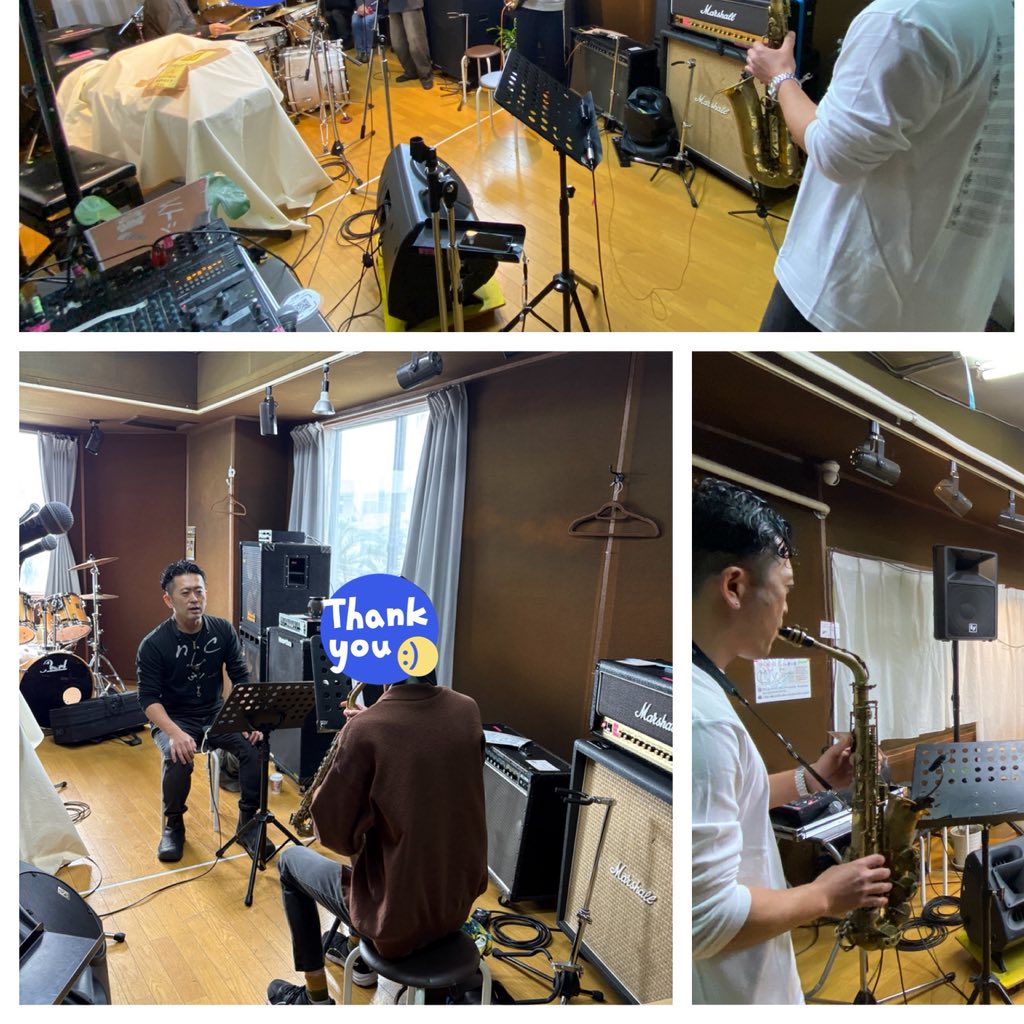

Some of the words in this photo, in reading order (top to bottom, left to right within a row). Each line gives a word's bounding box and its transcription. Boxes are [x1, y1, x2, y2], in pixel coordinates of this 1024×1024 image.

[699, 3, 737, 22] Marshall
[694, 94, 731, 115] Marshall
[609, 862, 658, 906] Marshall
